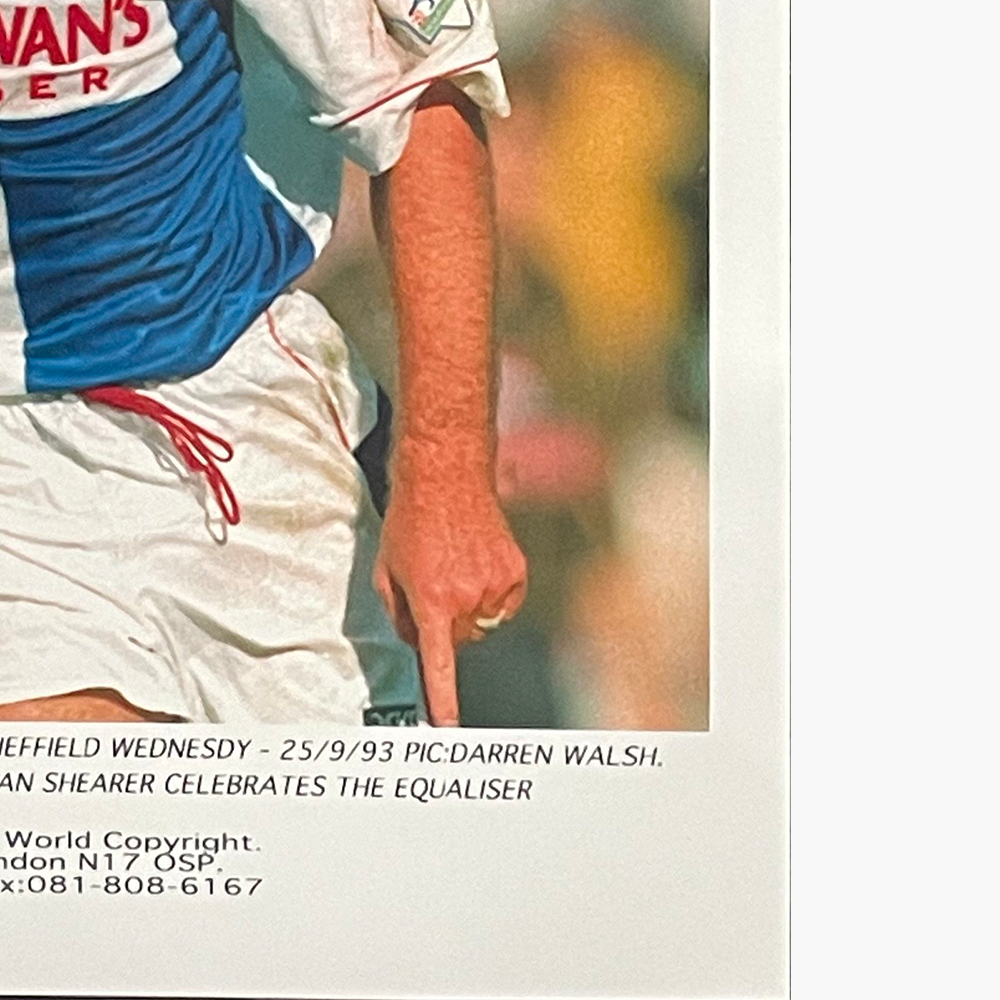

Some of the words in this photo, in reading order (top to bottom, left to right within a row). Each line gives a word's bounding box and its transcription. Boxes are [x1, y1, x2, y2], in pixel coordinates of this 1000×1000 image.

[112, 737, 253, 760] WEDNESDY
[279, 738, 395, 763] 25/9/93
[403, 741, 554, 766] PIC:DARREN
[564, 744, 663, 768] WALSH.
[41, 771, 156, 795] SHEARER
[164, 772, 328, 798] CELEBRATES
[337, 775, 386, 799] THE
[393, 777, 534, 804] EQUALISER
[4, 830, 91, 850] World
[103, 830, 261, 855] Copyright.
[78, 852, 141, 872] N17
